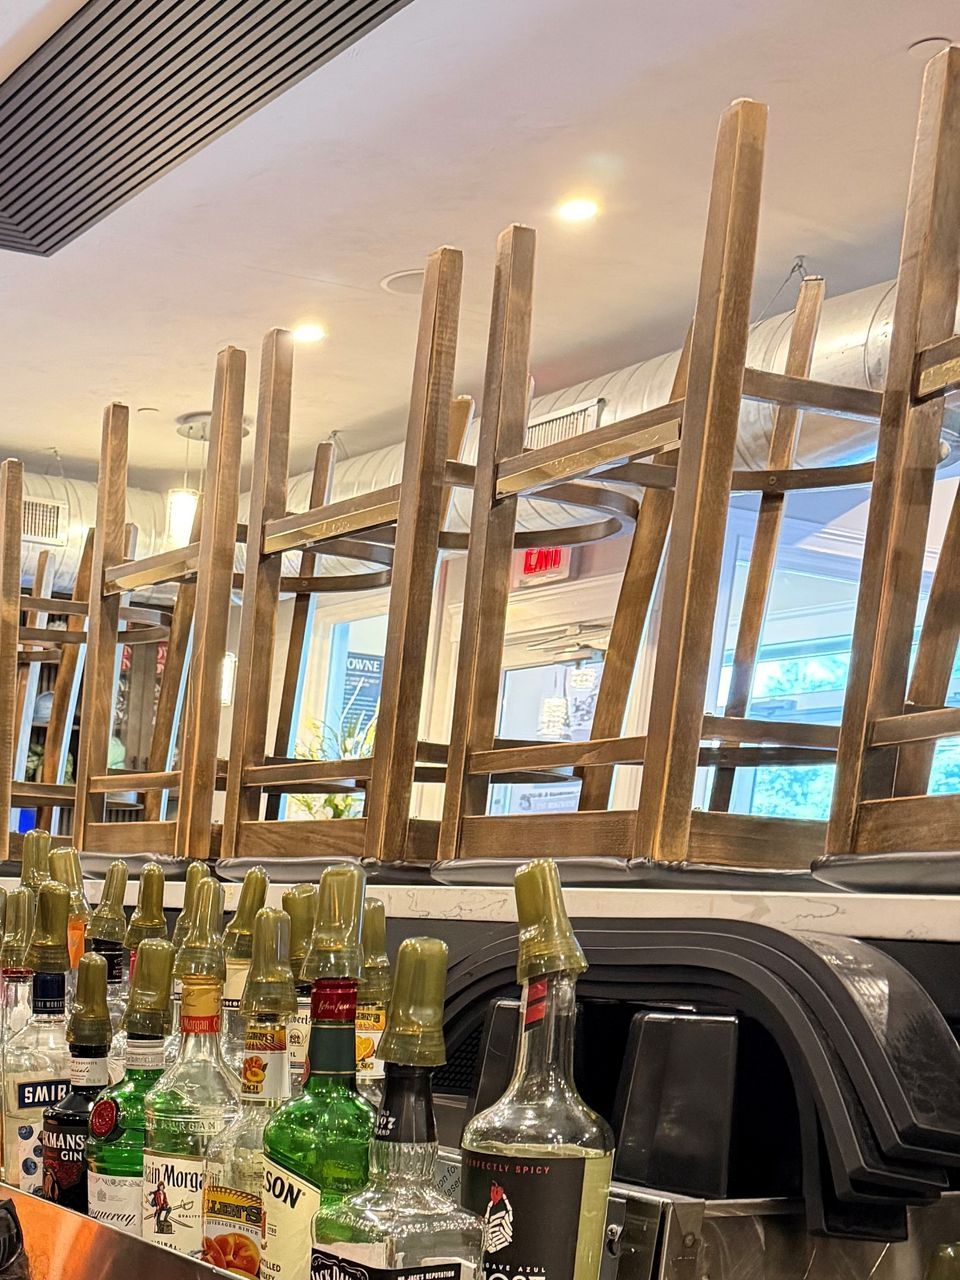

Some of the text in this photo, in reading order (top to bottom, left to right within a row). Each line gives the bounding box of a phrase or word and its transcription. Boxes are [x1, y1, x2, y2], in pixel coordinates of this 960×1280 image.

[60, 1151, 83, 1161] GIN
[515, 1165, 550, 1174] SPICY
[426, 1271, 455, 1280] REPUTATION
